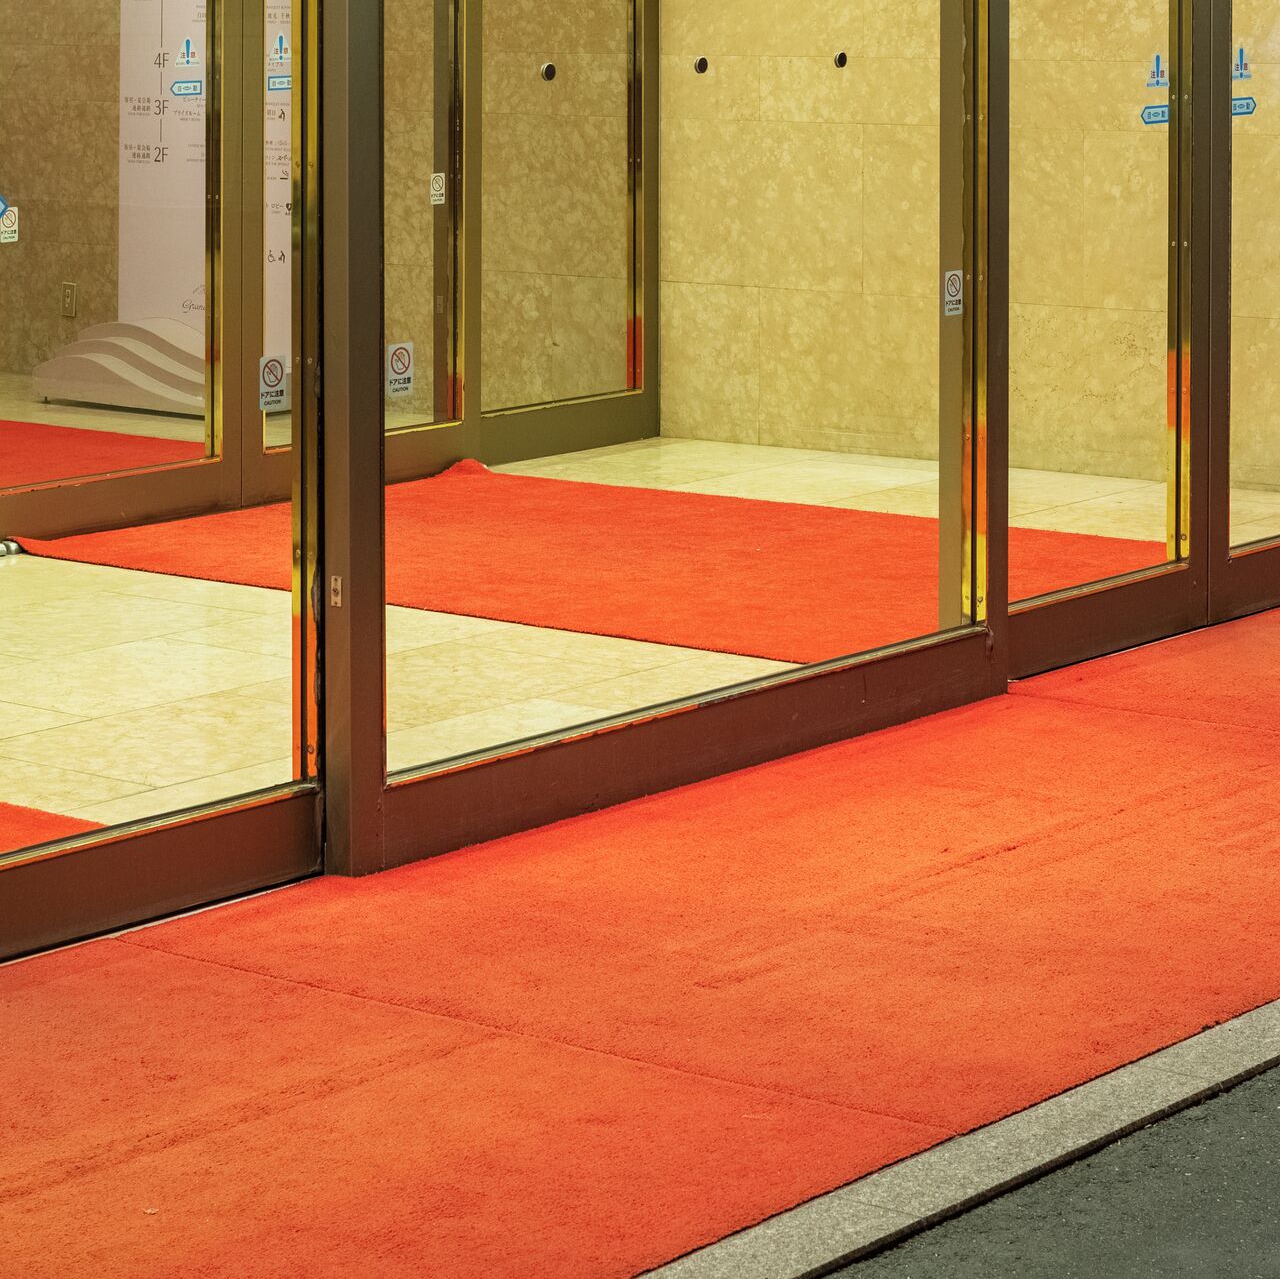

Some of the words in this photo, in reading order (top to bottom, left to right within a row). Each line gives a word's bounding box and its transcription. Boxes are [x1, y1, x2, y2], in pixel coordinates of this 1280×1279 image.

[153, 52, 169, 69] 4F
[153, 99, 169, 116] 3F
[153, 146, 169, 163] 2F
